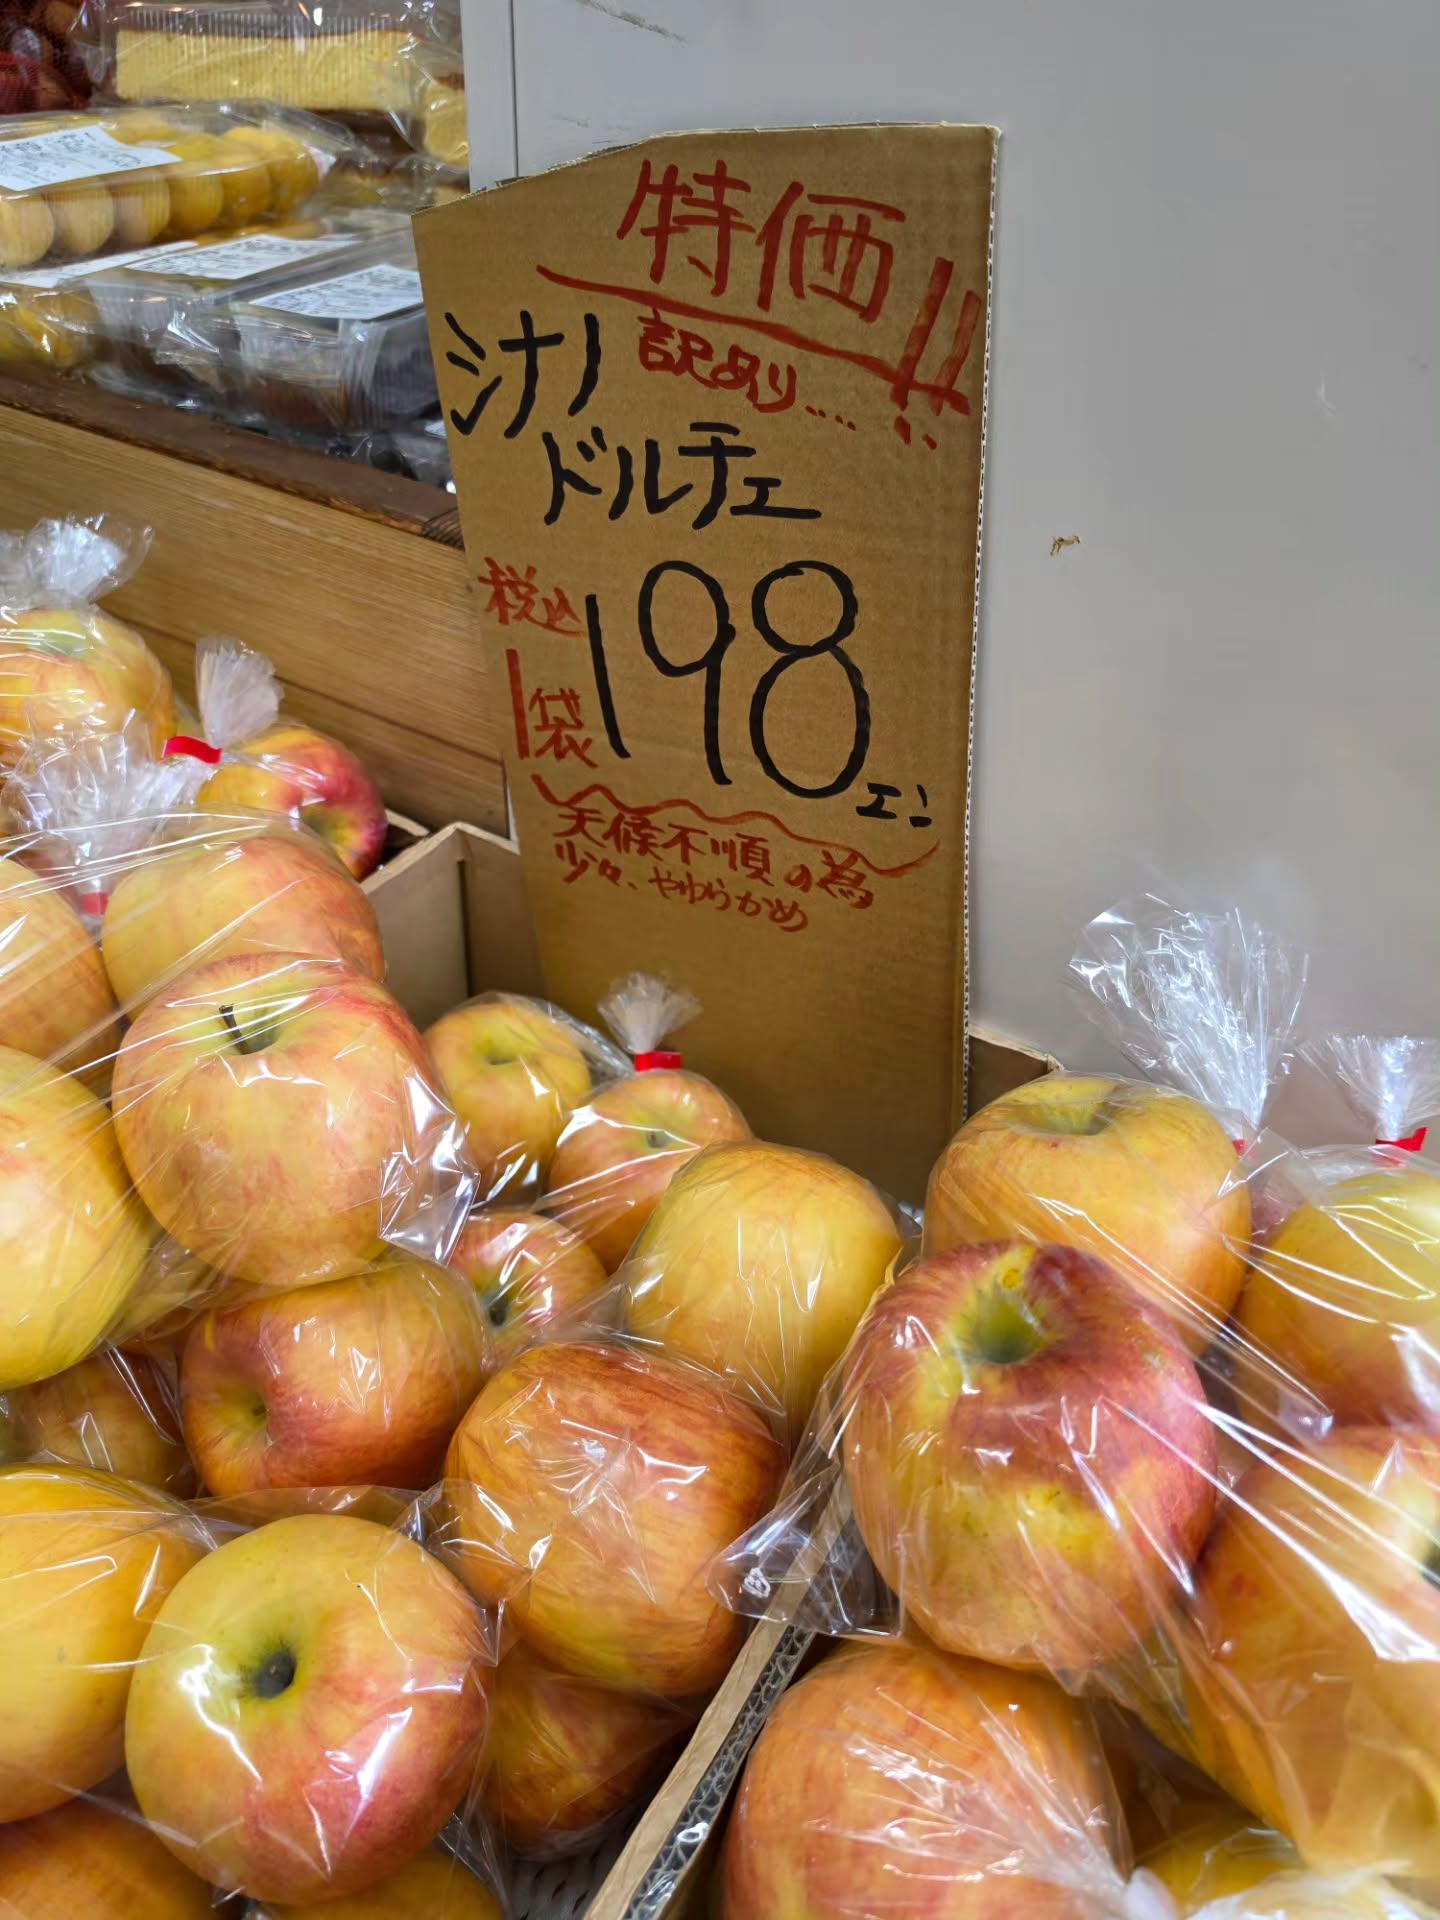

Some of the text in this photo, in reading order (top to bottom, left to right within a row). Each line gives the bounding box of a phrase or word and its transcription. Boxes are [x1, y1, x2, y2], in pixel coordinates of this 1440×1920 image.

[445, 311, 600, 436] シナノ
[543, 422, 822, 530] ドルチェ
[478, 557, 587, 636] 税込
